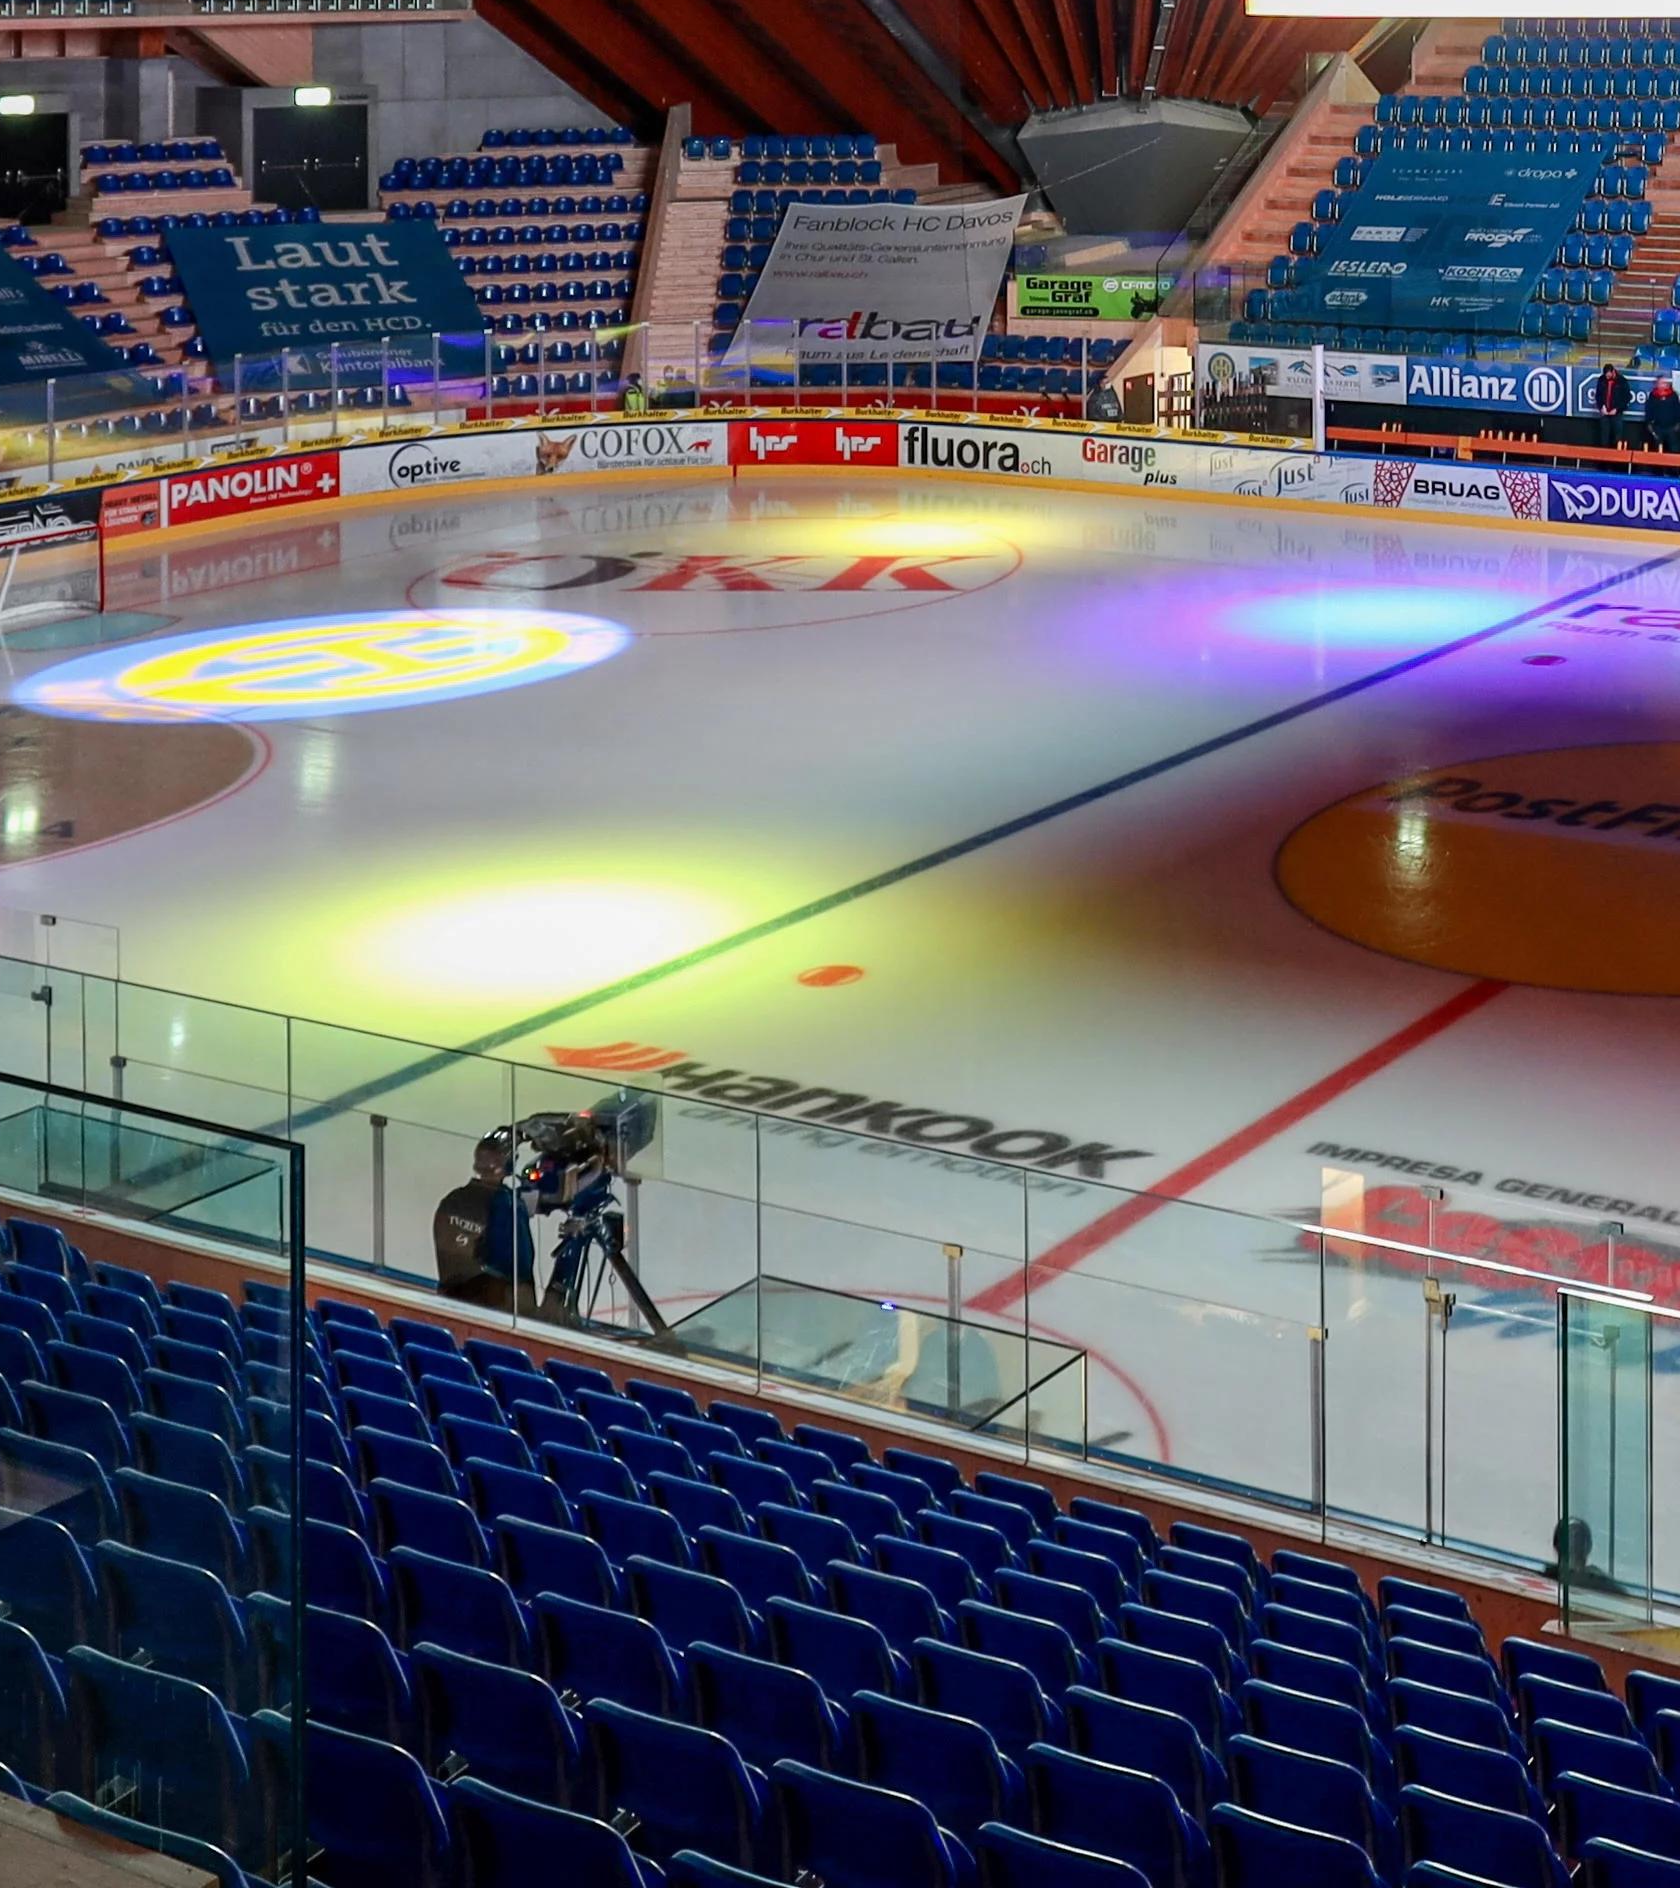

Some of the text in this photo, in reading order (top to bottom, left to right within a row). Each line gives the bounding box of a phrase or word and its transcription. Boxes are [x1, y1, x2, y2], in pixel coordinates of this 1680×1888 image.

[1518, 168, 1562, 180] dropa
[793, 211, 1014, 233] Fanblock HC Davos
[224, 233, 399, 271] Laut
[246, 273, 417, 311] stark
[1026, 277, 1093, 292] Garage
[1051, 290, 1092, 304] Graf
[260, 316, 432, 336] für den HCD.
[1409, 366, 1517, 401] Allianz
[580, 426, 686, 459] COFOX
[749, 427, 797, 460] hrs
[835, 427, 882, 460] hrs
[1082, 438, 1156, 467] Garage
[397, 457, 461, 483] optive
[1143, 470, 1177, 486] plus
[1276, 464, 1315, 497] Just
[171, 464, 298, 509] PANOLIN
[1414, 478, 1500, 500] BRUAG
[1307, 1142, 1485, 1188] IMPRESA
